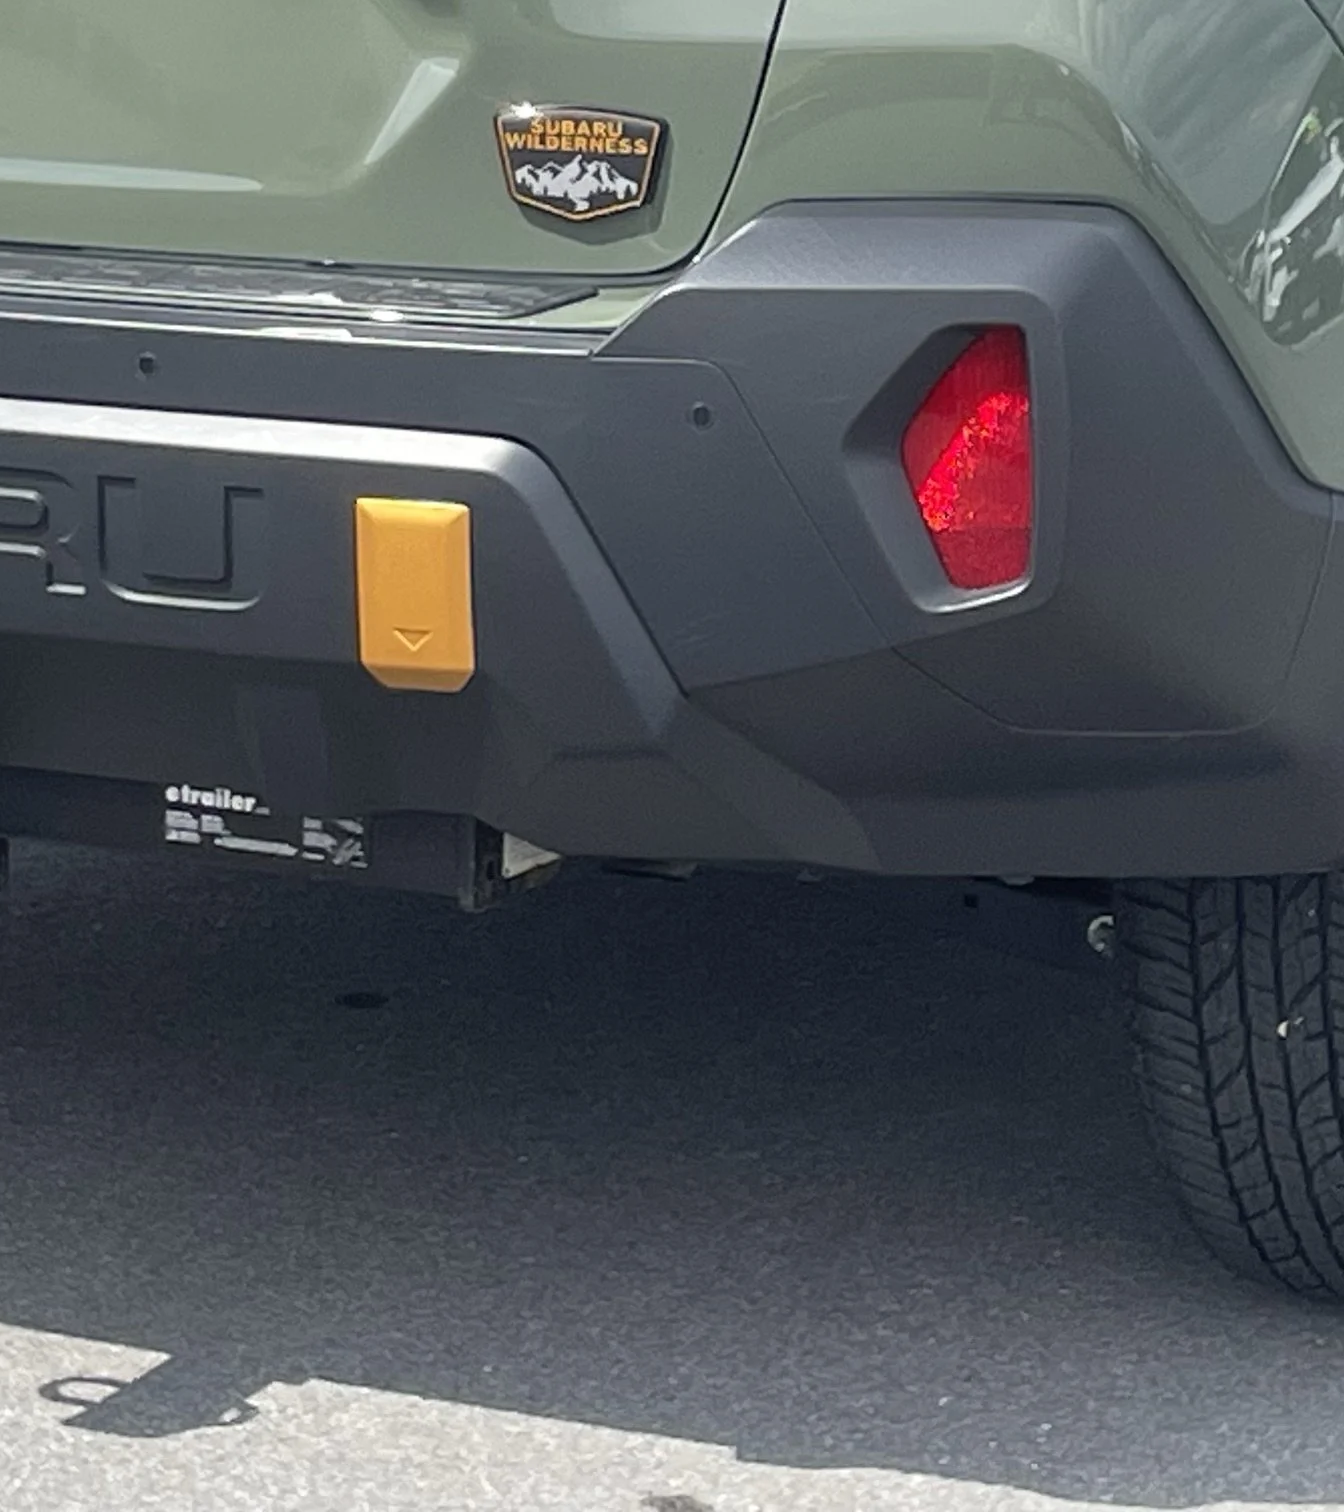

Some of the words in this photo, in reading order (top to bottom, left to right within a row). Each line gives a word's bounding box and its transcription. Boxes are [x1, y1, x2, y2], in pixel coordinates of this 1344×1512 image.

[530, 118, 624, 138] SUBARU
[505, 132, 649, 156] WILDERNESS
[164, 784, 257, 813] etrailer
